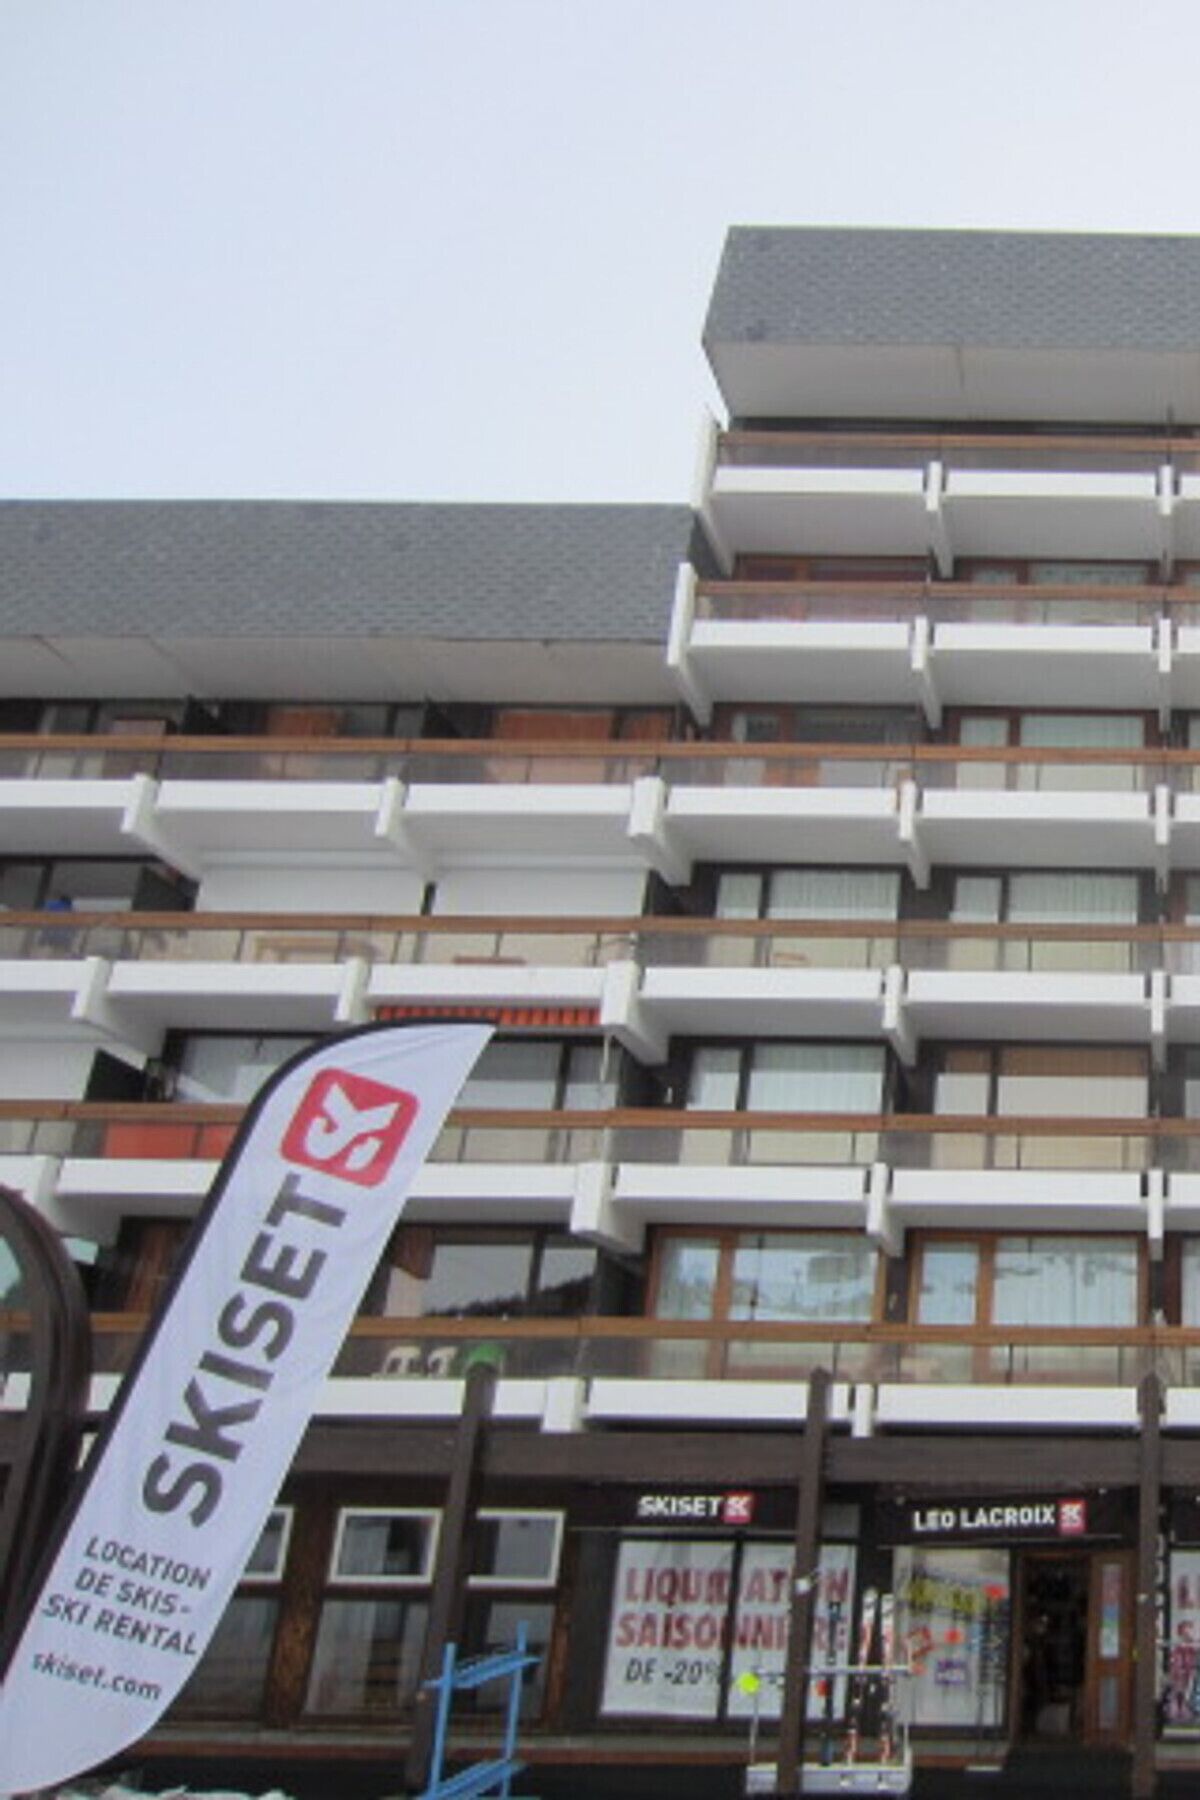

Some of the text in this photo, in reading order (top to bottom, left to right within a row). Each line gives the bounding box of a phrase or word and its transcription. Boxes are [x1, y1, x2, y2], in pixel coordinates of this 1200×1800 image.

[142, 1173, 346, 1527] SKISET
[637, 1496, 721, 1517] SKISET
[914, 1504, 1056, 1531] LEO LACROIX
[84, 1535, 212, 1589] LOCATION
[75, 1566, 192, 1617] DE SKIS-
[42, 1594, 198, 1655] SKI RENTAL
[33, 1651, 162, 1700] skiset.com
[625, 1656, 658, 1684] DE
